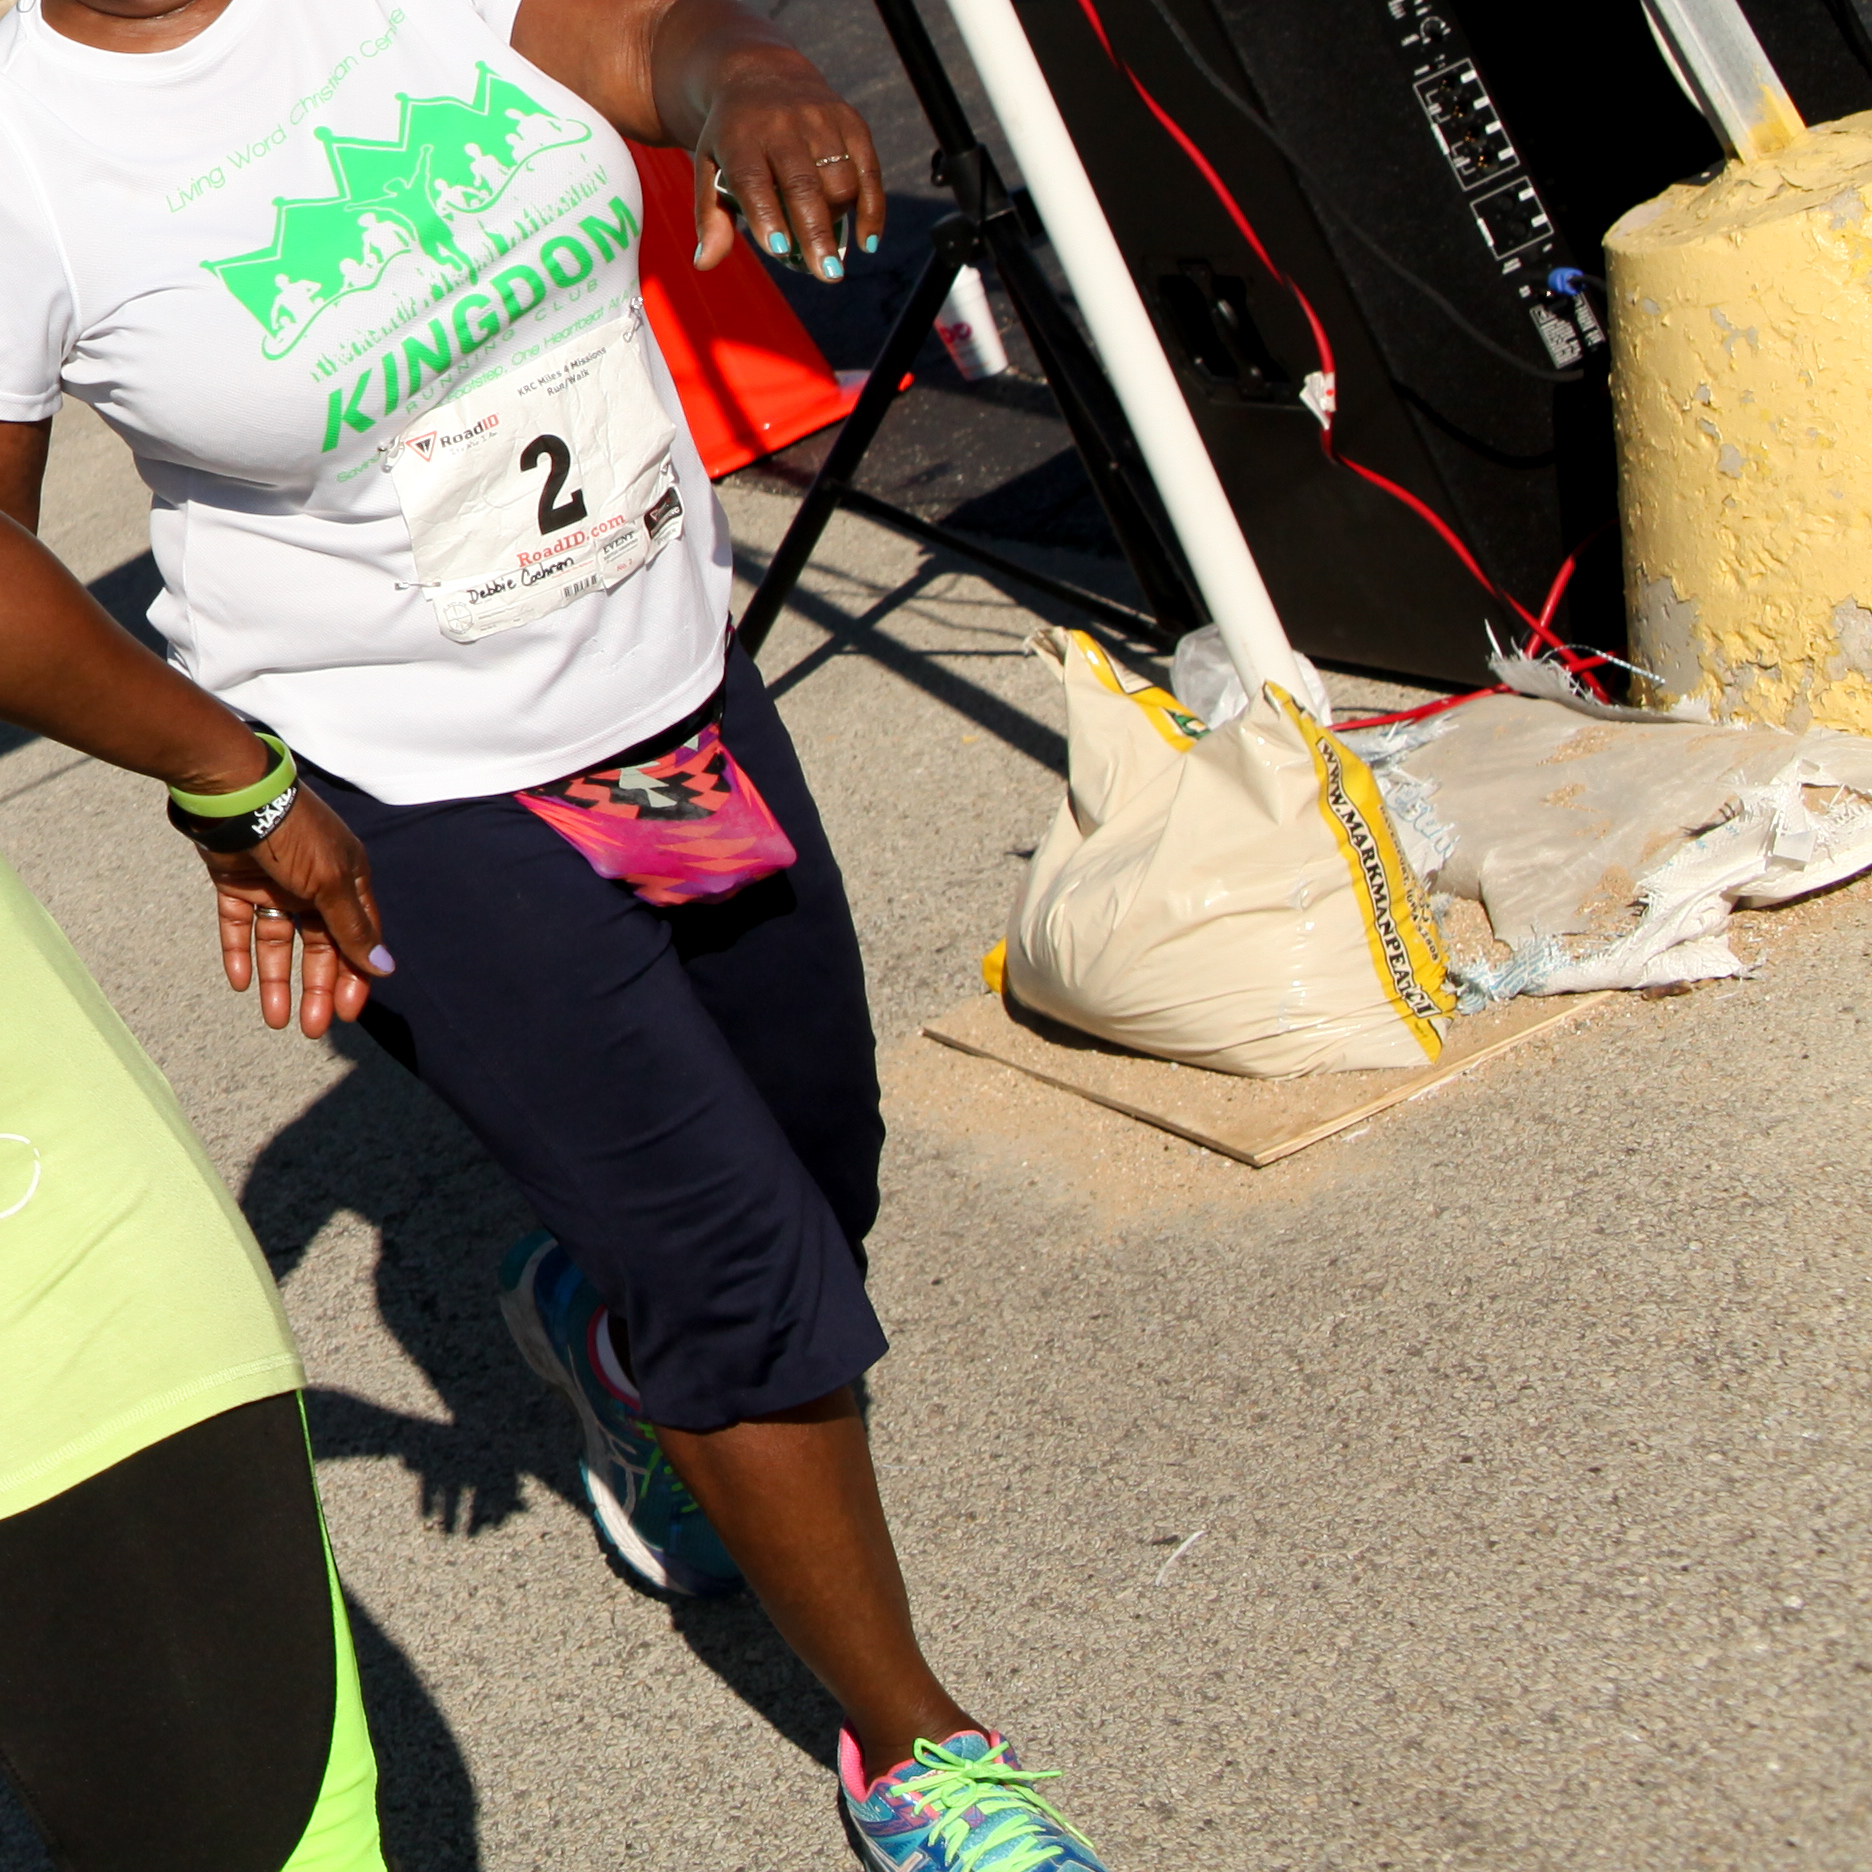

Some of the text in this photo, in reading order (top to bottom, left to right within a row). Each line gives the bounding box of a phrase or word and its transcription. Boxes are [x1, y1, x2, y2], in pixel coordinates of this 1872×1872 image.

[165, 166, 226, 213] Living
[227, 124, 288, 169] Word
[289, 55, 359, 125] Christian
[322, 196, 641, 454] KINGDOM
[407, 278, 598, 414] RUNNING CLUB
[440, 413, 500, 448] RoadID
[520, 434, 588, 536] 2
[466, 577, 517, 605] Debbie
[516, 513, 626, 568] RoadID.com
